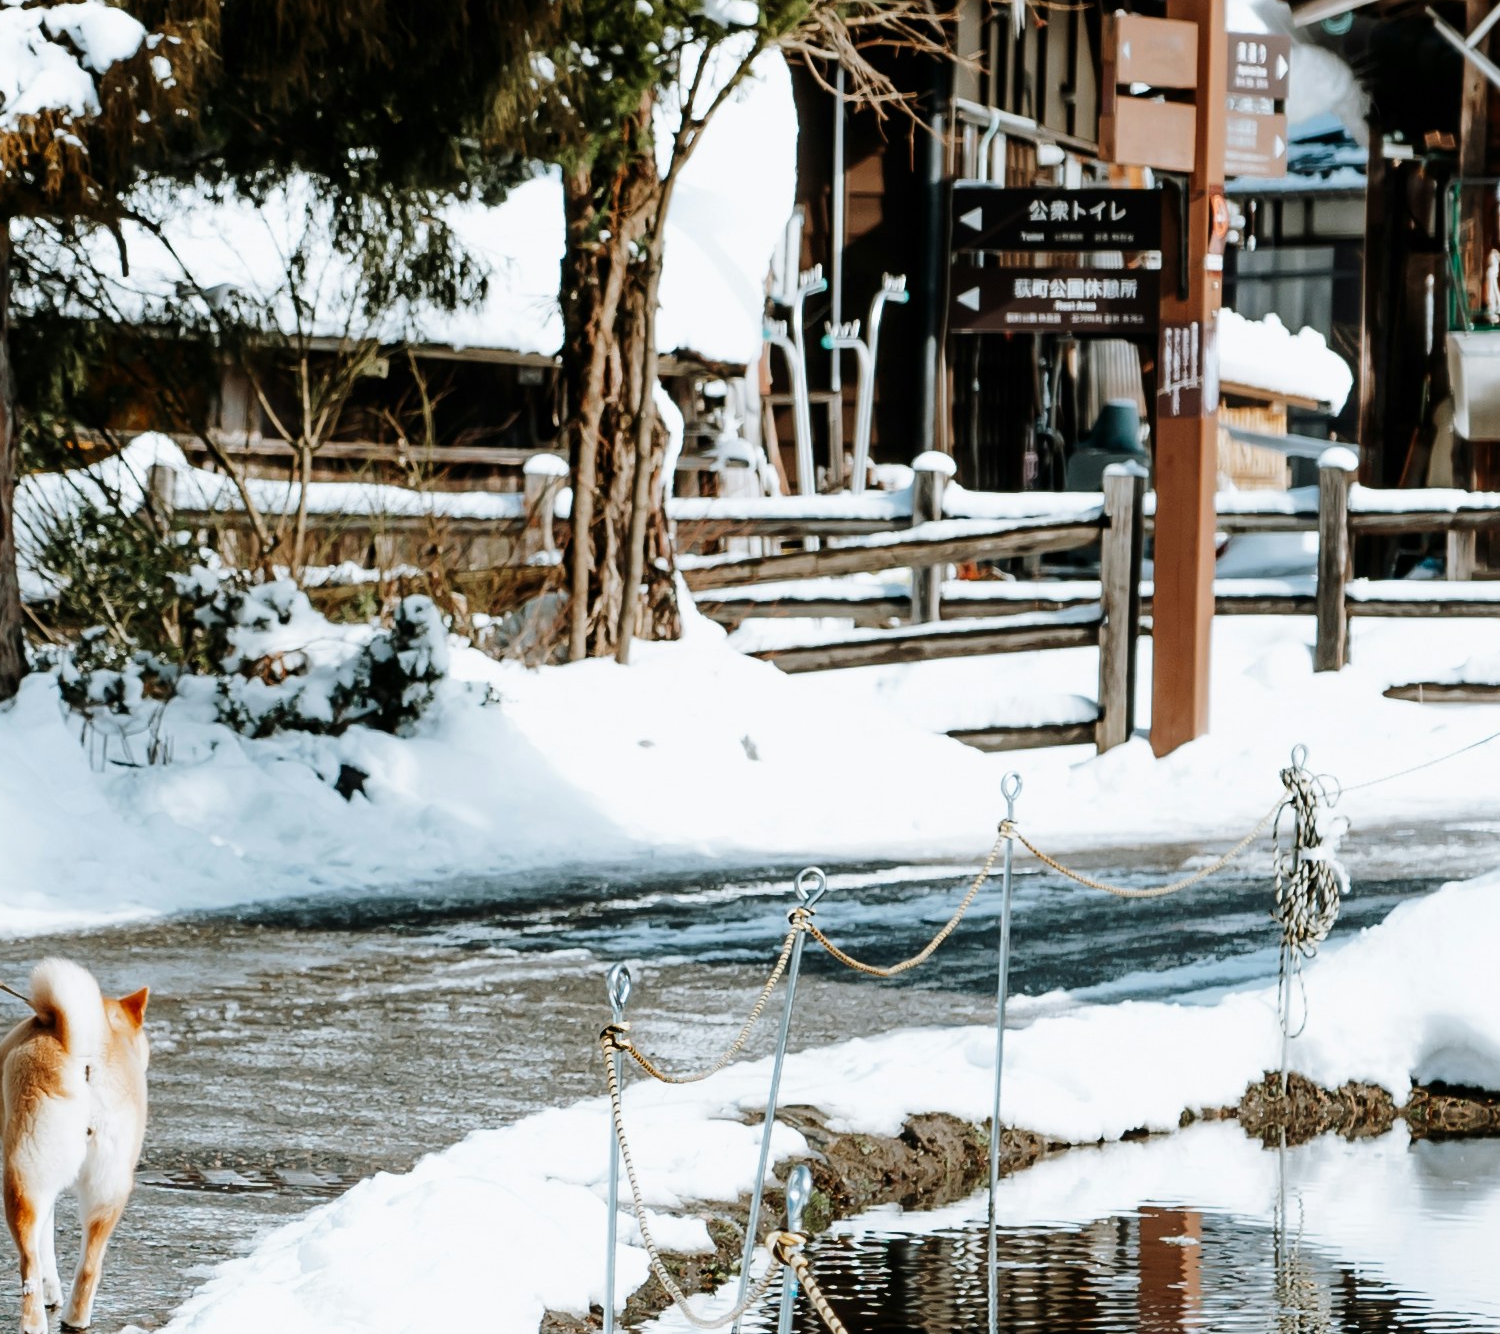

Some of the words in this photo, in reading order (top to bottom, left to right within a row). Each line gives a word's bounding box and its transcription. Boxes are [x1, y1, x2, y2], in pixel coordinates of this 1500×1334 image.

[1029, 199, 1127, 221] 公衆トイレ
